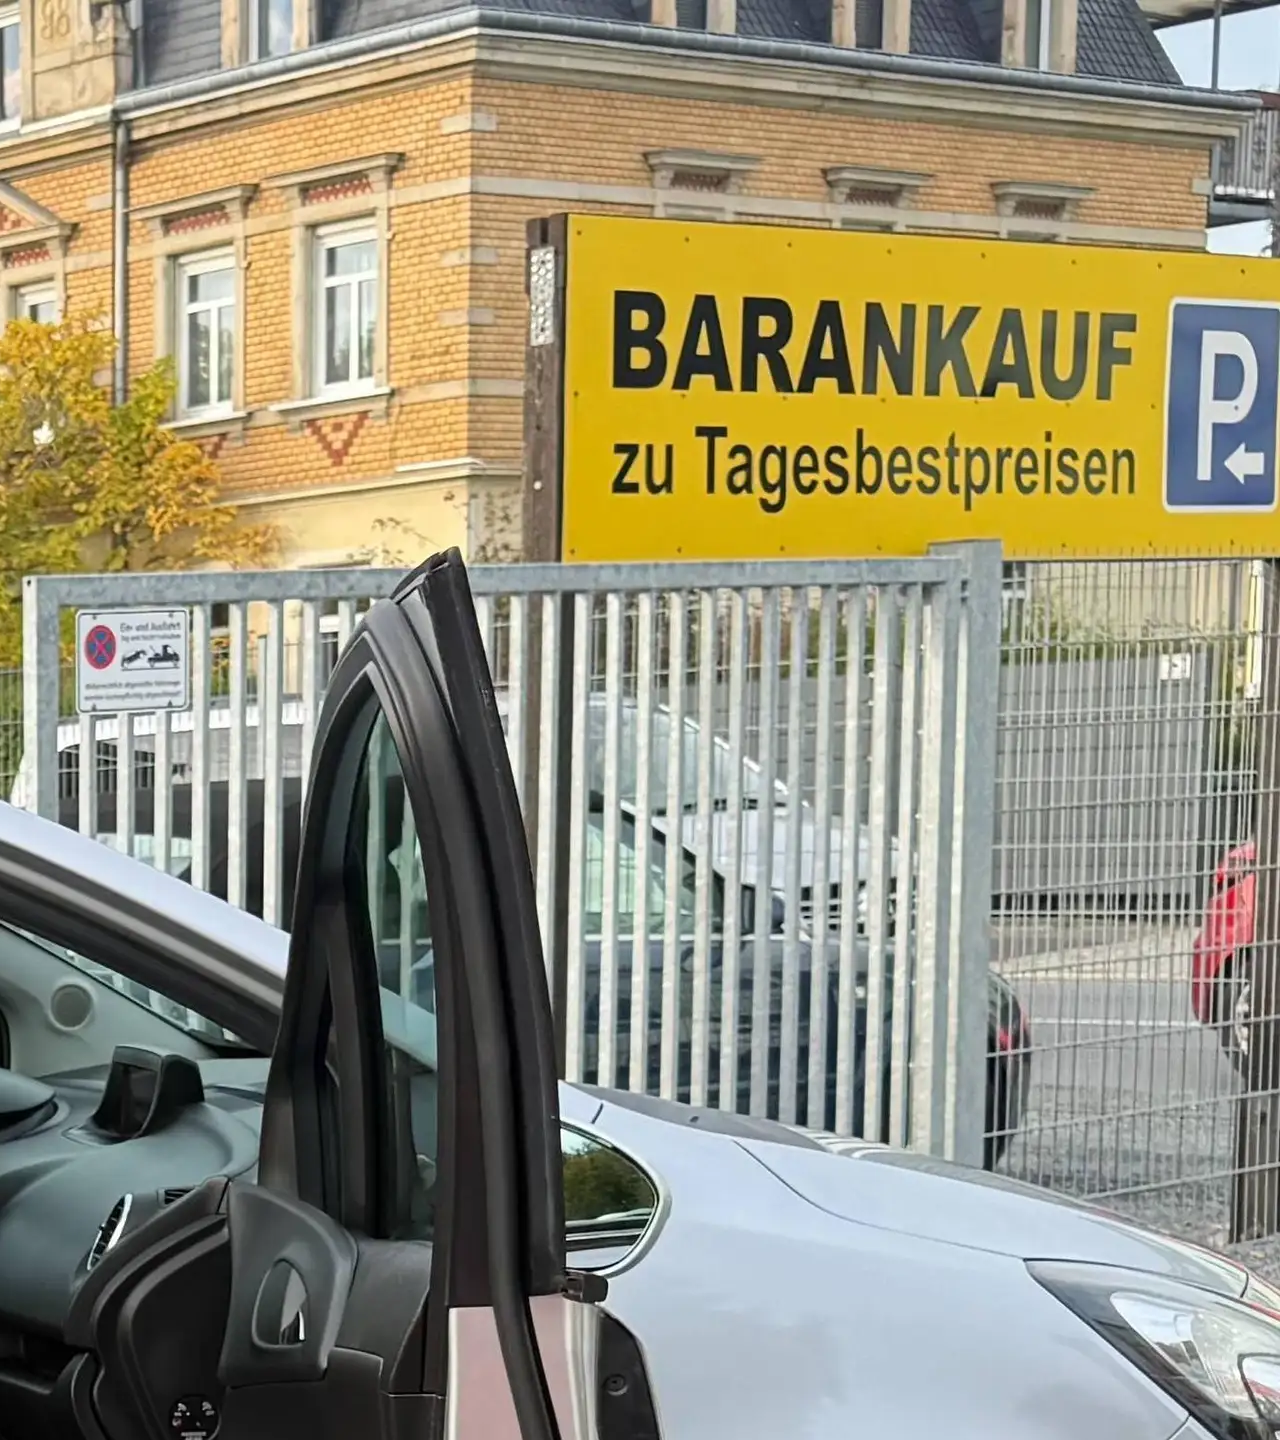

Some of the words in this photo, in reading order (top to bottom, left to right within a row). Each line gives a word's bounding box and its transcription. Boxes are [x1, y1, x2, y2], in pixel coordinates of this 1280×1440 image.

[611, 289, 1139, 402] BARANKAUF
[1197, 330, 1259, 482] P
[611, 443, 675, 495] zu
[695, 425, 1137, 515] Tagesbestpreisen
